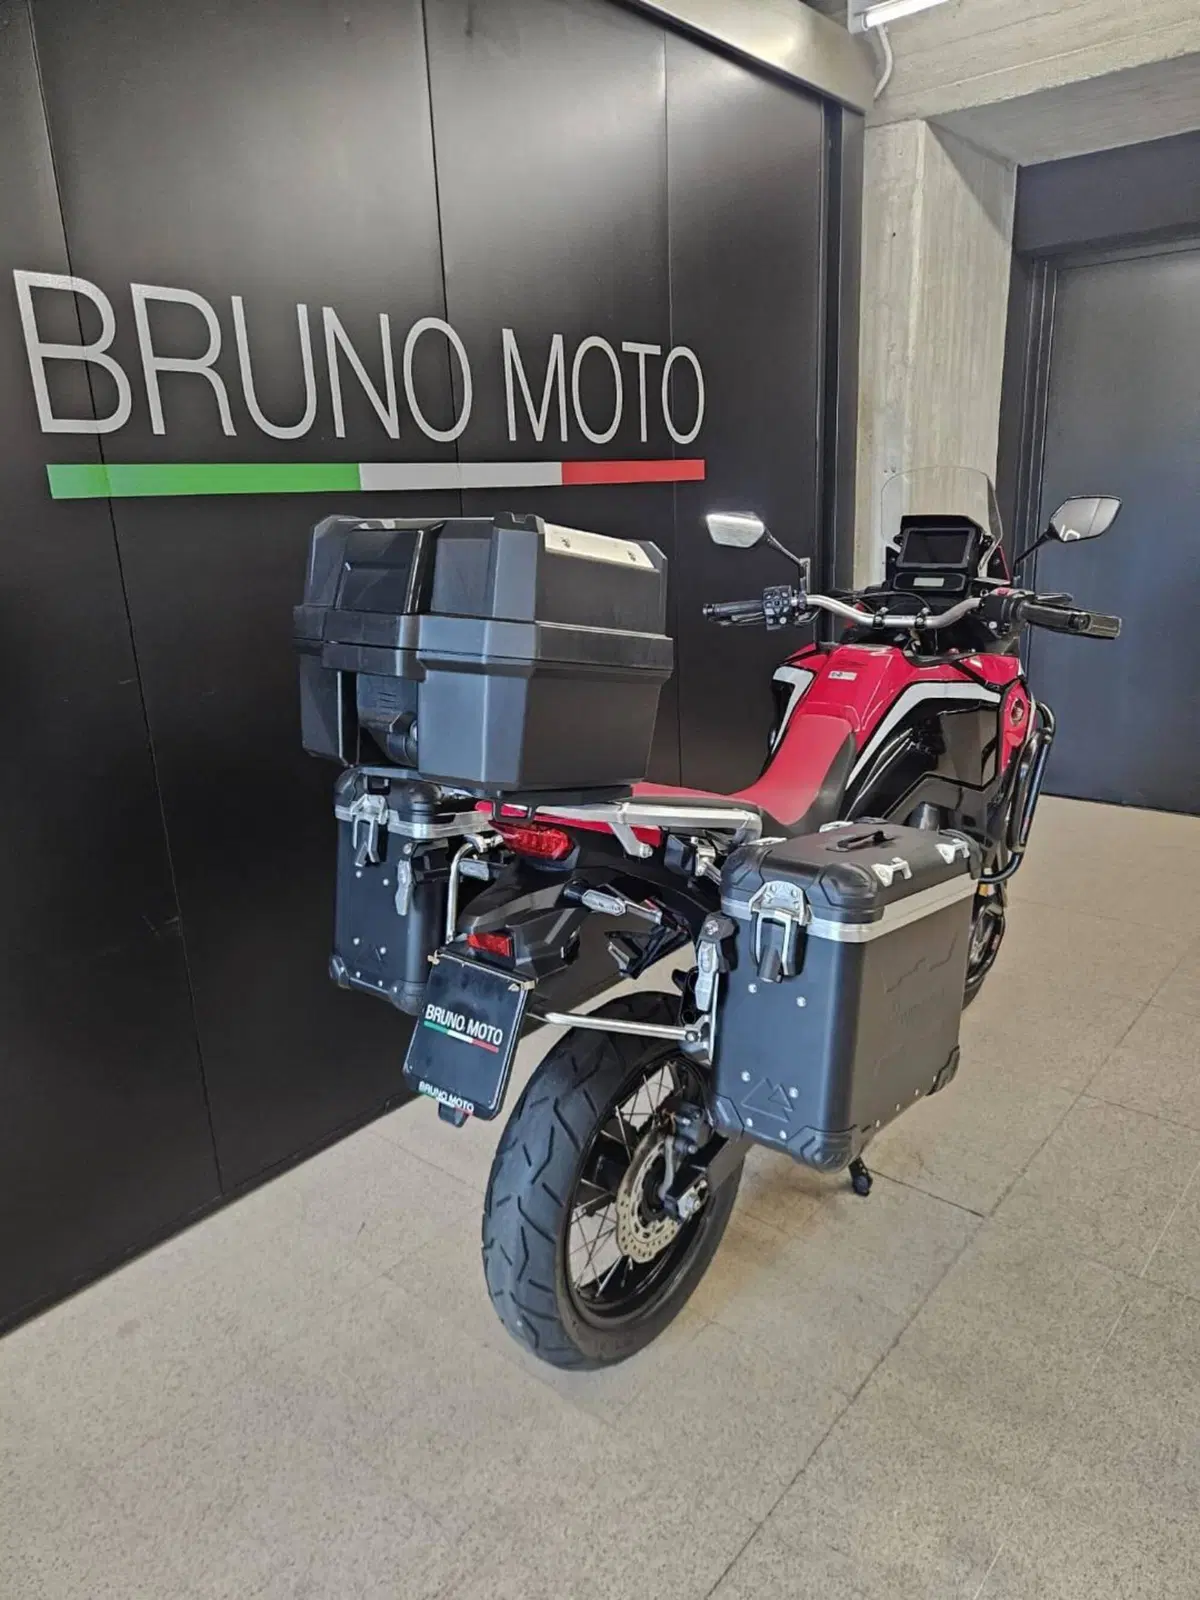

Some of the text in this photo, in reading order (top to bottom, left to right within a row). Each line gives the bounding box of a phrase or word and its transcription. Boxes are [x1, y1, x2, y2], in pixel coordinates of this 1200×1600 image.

[12, 269, 705, 445] BRUNO MOTO
[425, 1003, 503, 1046] BRUNO MOTO
[418, 1081, 474, 1112] BRUNO MOTO
